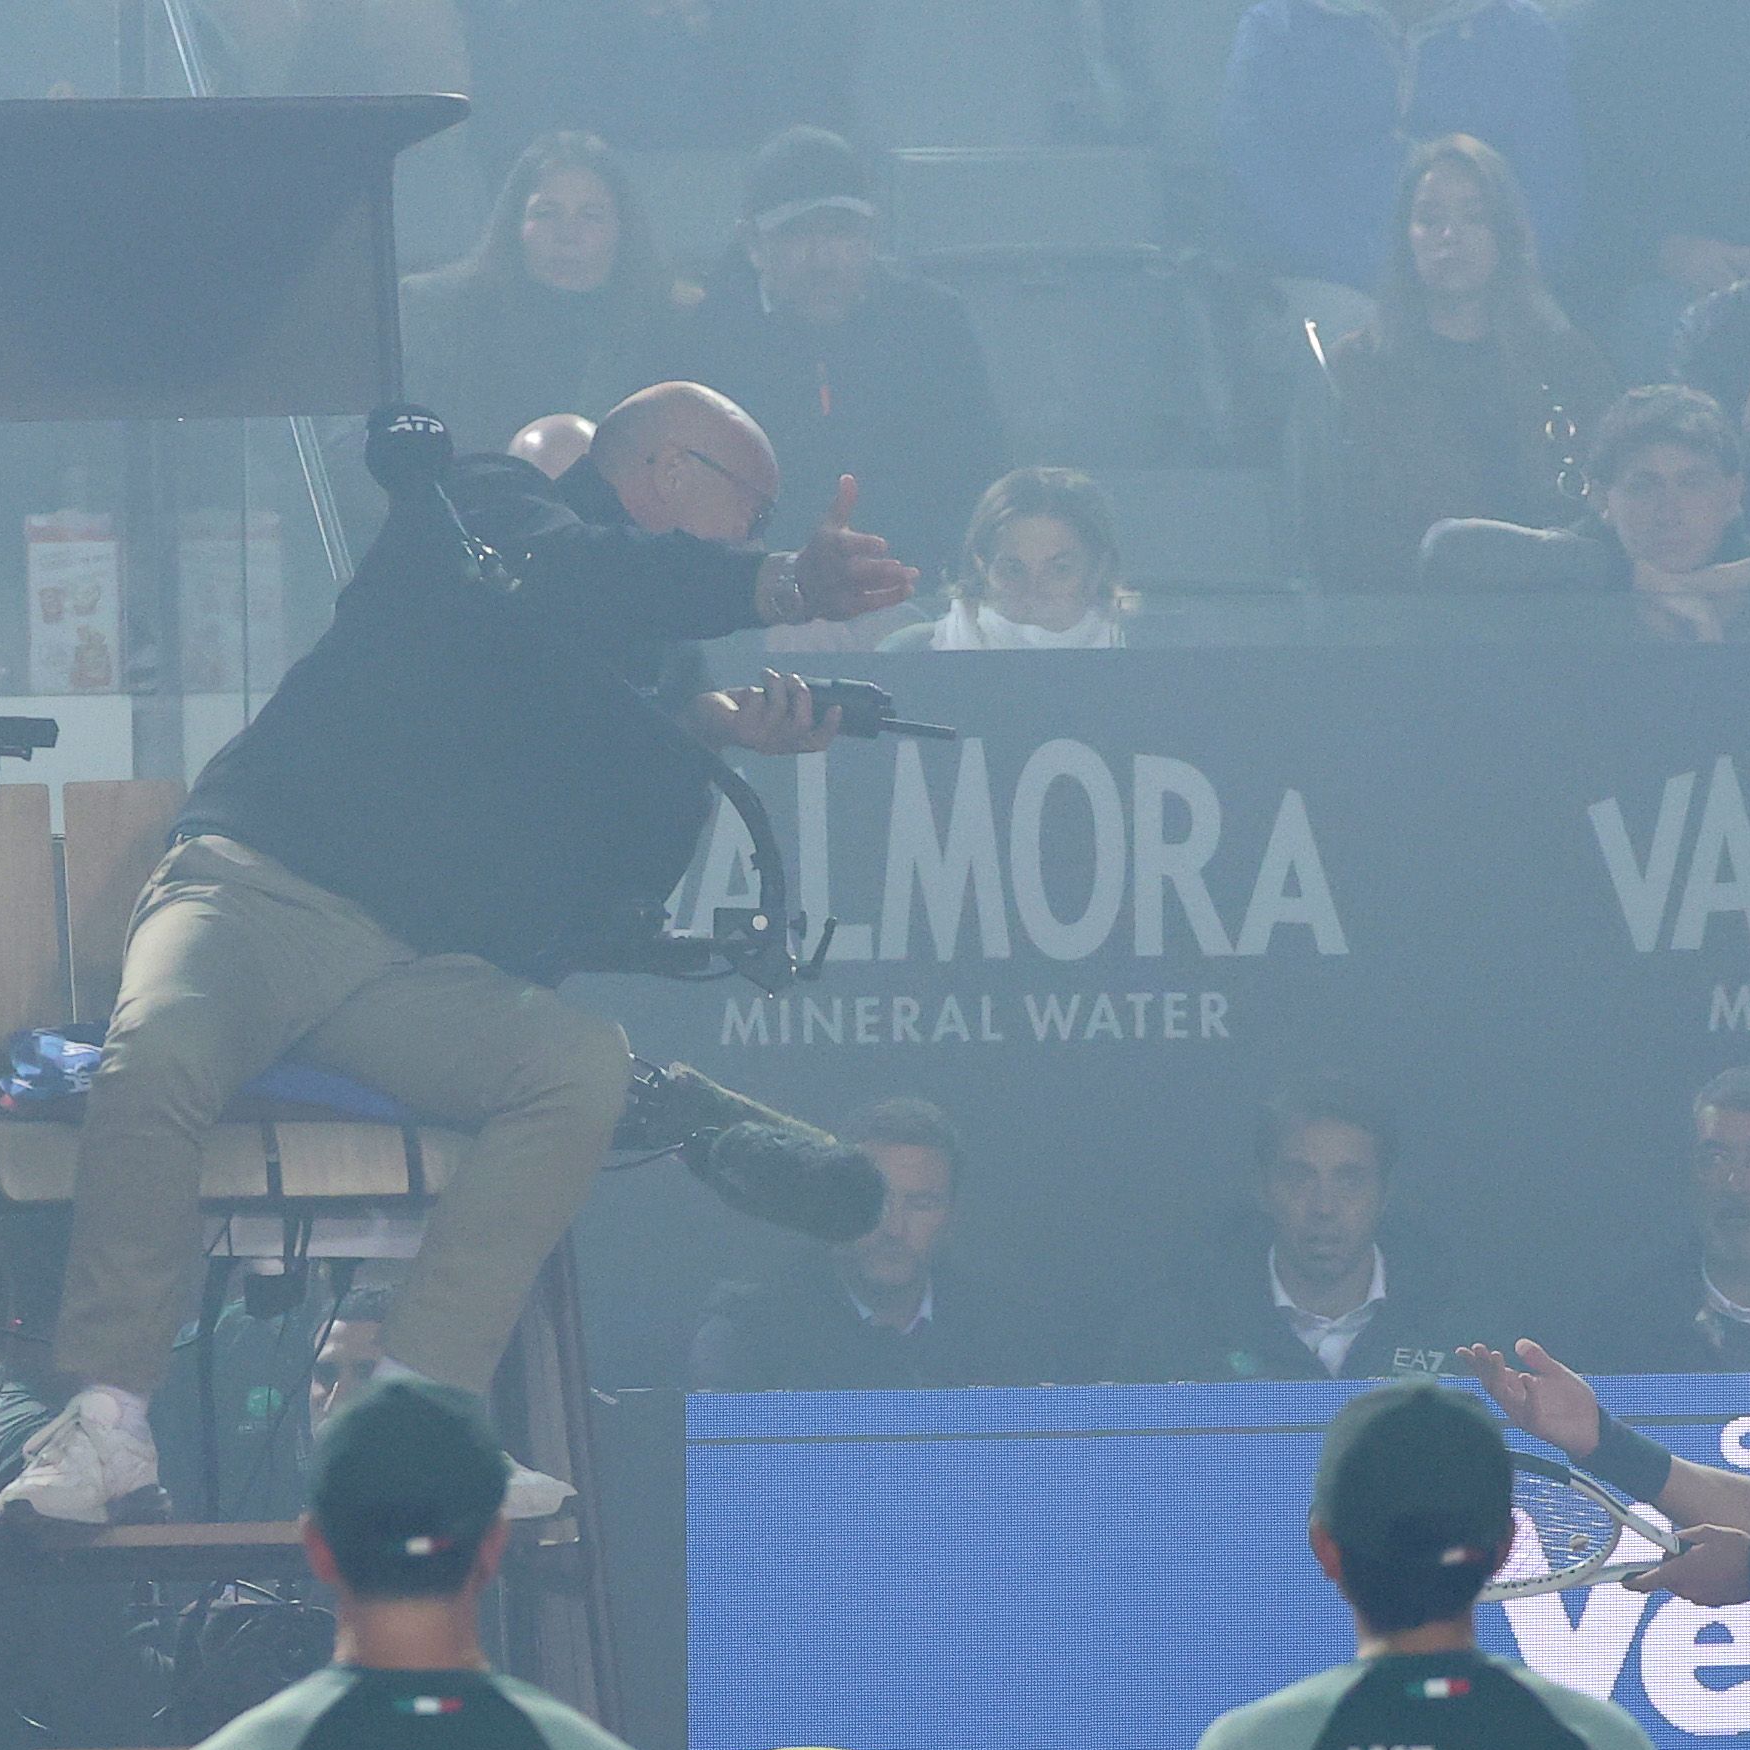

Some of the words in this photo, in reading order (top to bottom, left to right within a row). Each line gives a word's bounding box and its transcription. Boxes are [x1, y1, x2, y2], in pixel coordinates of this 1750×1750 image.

[387, 415, 445, 435] ATP
[720, 994, 1003, 1046] MINERAL
[1026, 991, 1232, 1040] WATER
[1392, 1346, 1446, 1375] EA7
